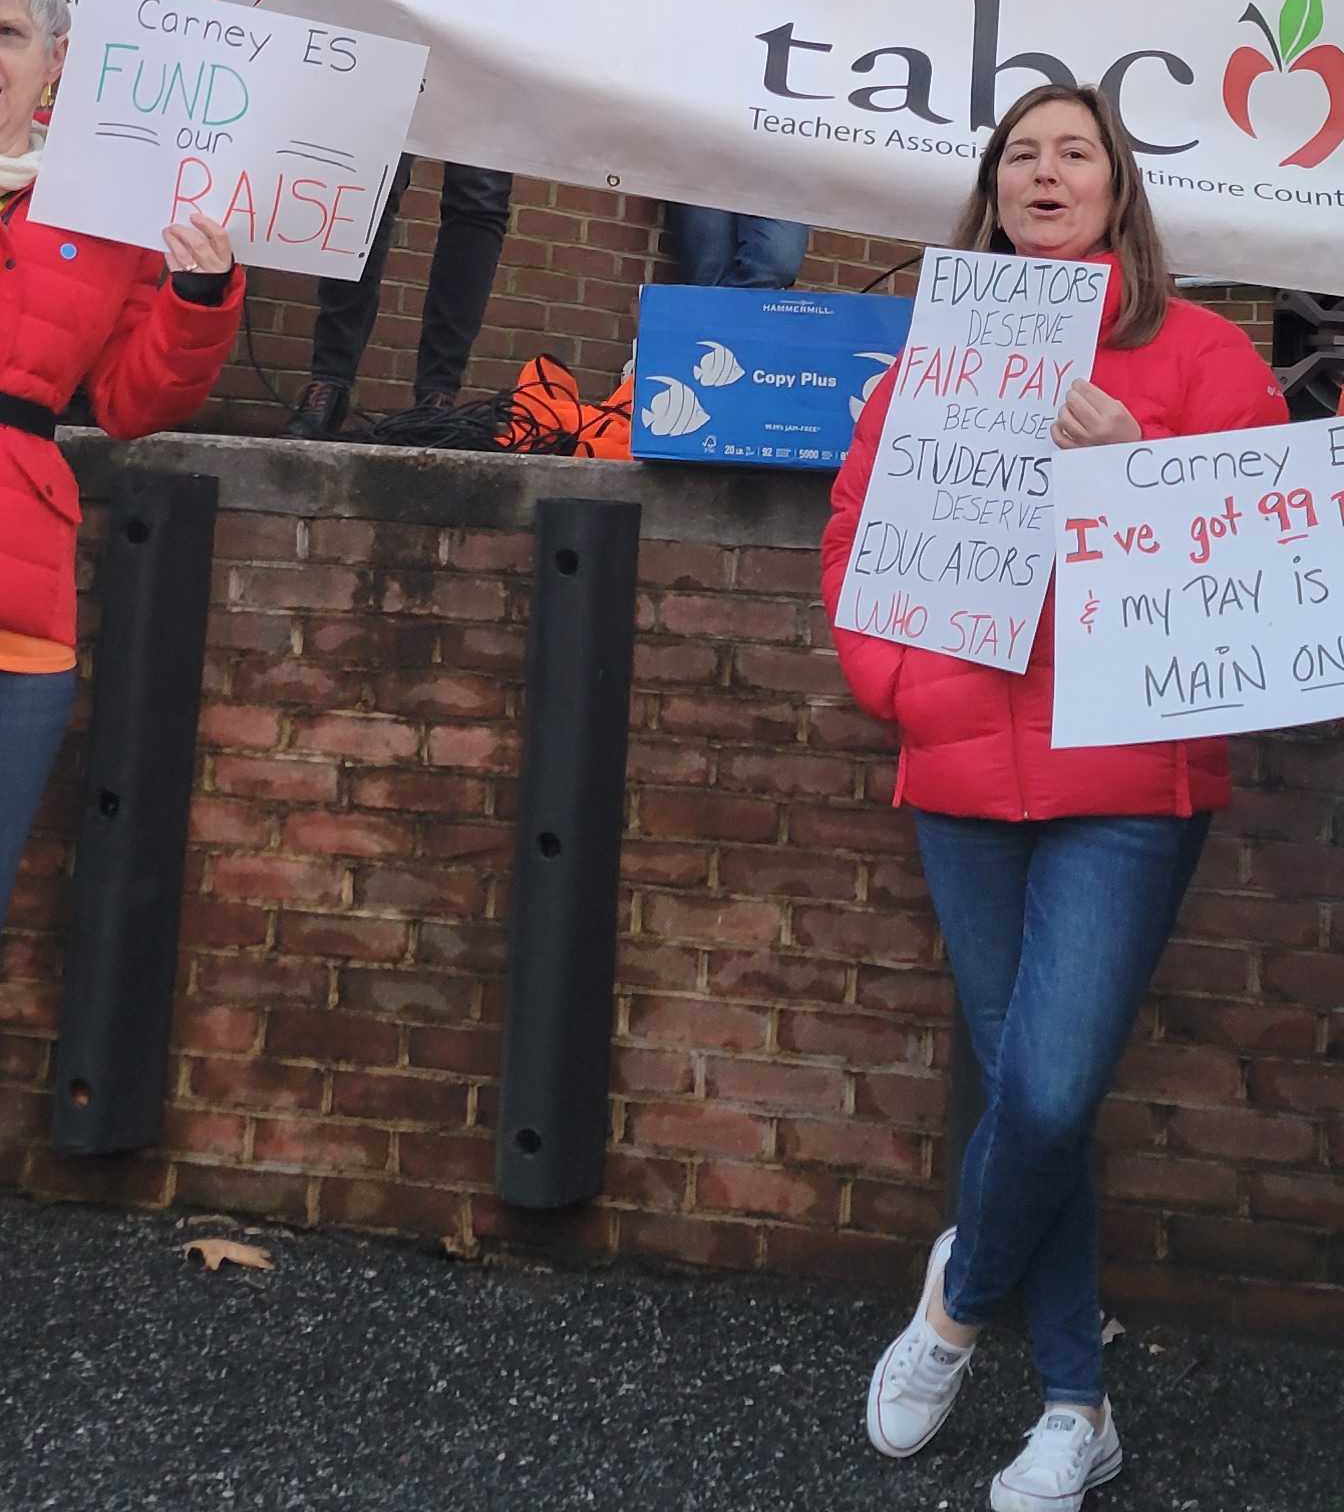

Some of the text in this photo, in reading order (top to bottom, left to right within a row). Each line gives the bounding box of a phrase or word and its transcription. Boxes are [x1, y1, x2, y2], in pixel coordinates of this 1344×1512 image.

[303, 29, 357, 72] ES
[97, 43, 249, 125] FUND
[176, 128, 233, 153] our
[748, 106, 877, 145] Teachers
[170, 157, 389, 258] RAISE!
[930, 256, 1104, 305] EDUCATORS
[967, 309, 1073, 347] DESERVE
[752, 369, 838, 388] Copy Plus
[898, 345, 1075, 407] FAIR PAY
[943, 403, 1053, 440] BECAUSE
[887, 434, 1052, 496] STUDENTS
[1126, 445, 1290, 488] Carney
[932, 489, 1054, 530] DESERVE
[1064, 515, 1160, 563] I've
[1190, 495, 1242, 563] got
[1257, 487, 1319, 532] 99
[855, 520, 1040, 586] EDUCATORS
[1080, 590, 1100, 634] &
[1182, 570, 1263, 616] PAY
[1293, 555, 1329, 605] is
[856, 589, 1029, 660] WHO STAY
